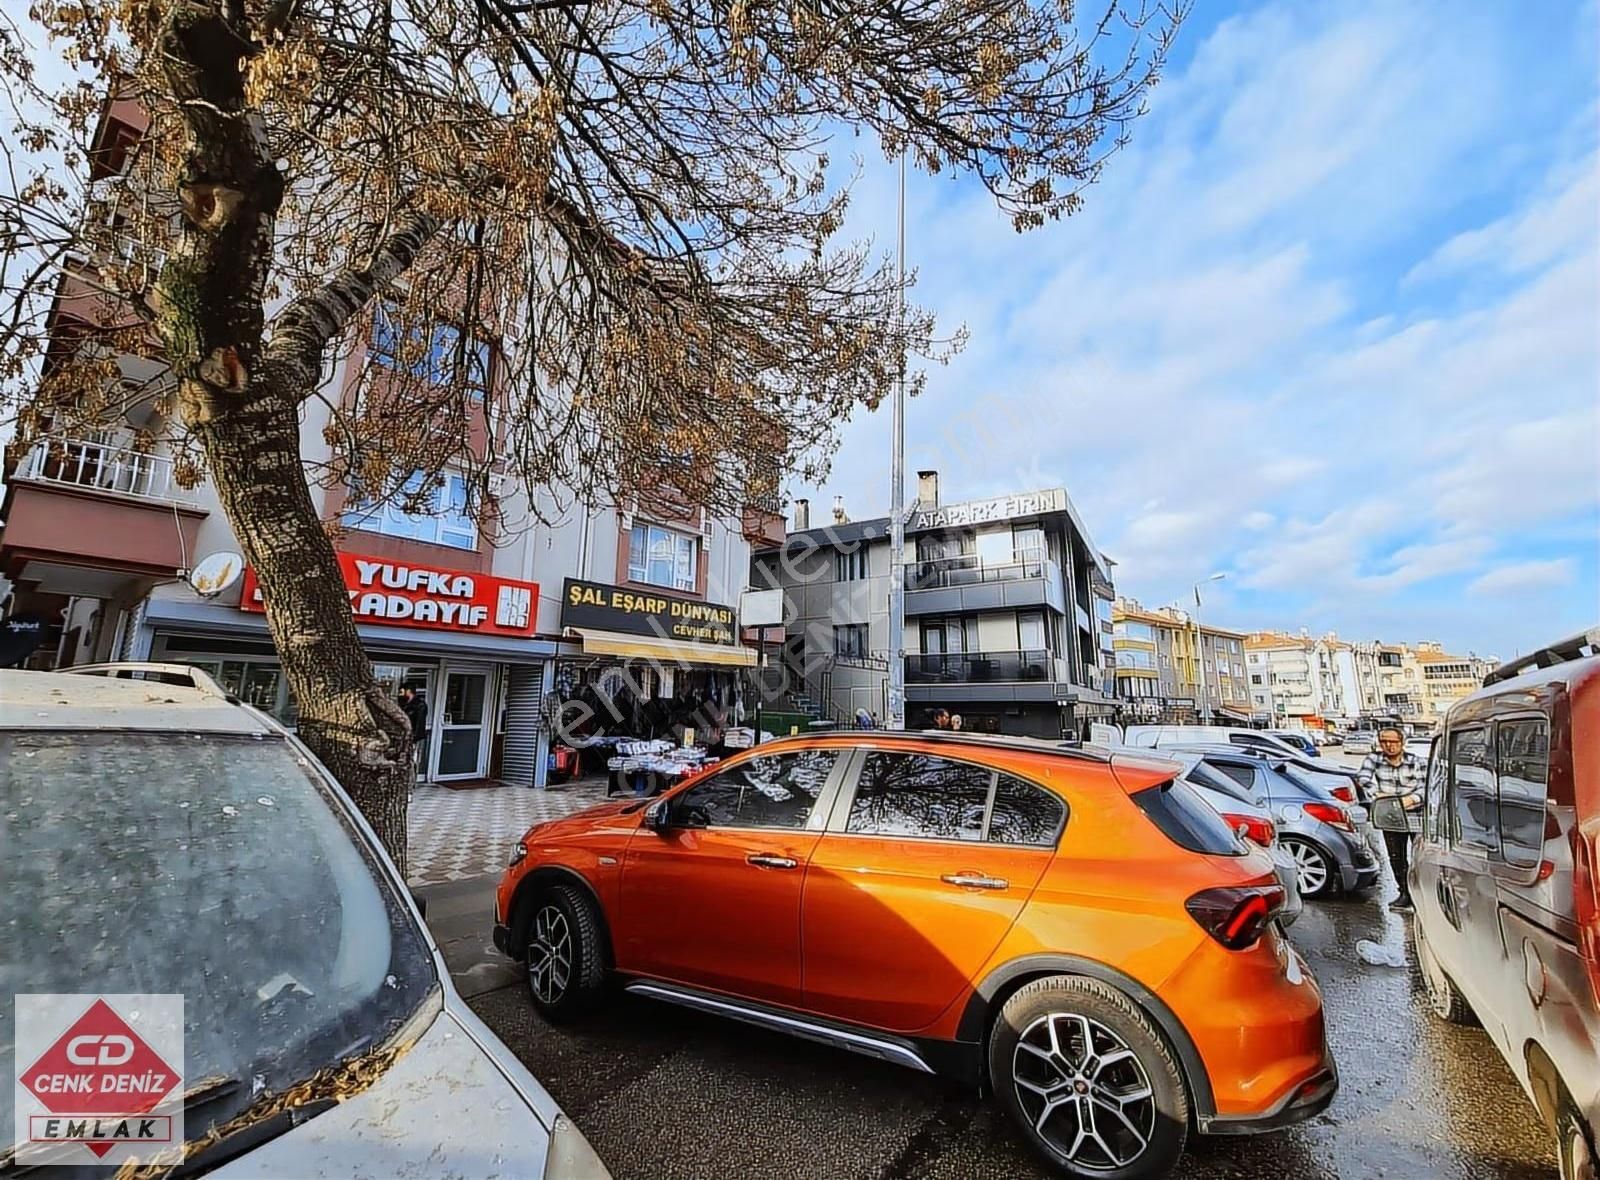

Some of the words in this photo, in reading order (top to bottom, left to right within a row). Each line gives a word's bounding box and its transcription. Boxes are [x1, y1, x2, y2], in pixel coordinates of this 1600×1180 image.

[917, 500, 997, 528] ATAPARK
[355, 561, 474, 598] YUFKA
[569, 585, 606, 605] ŞAL
[612, 593, 666, 613] EŞARP
[671, 602, 732, 623] DÜNYASI
